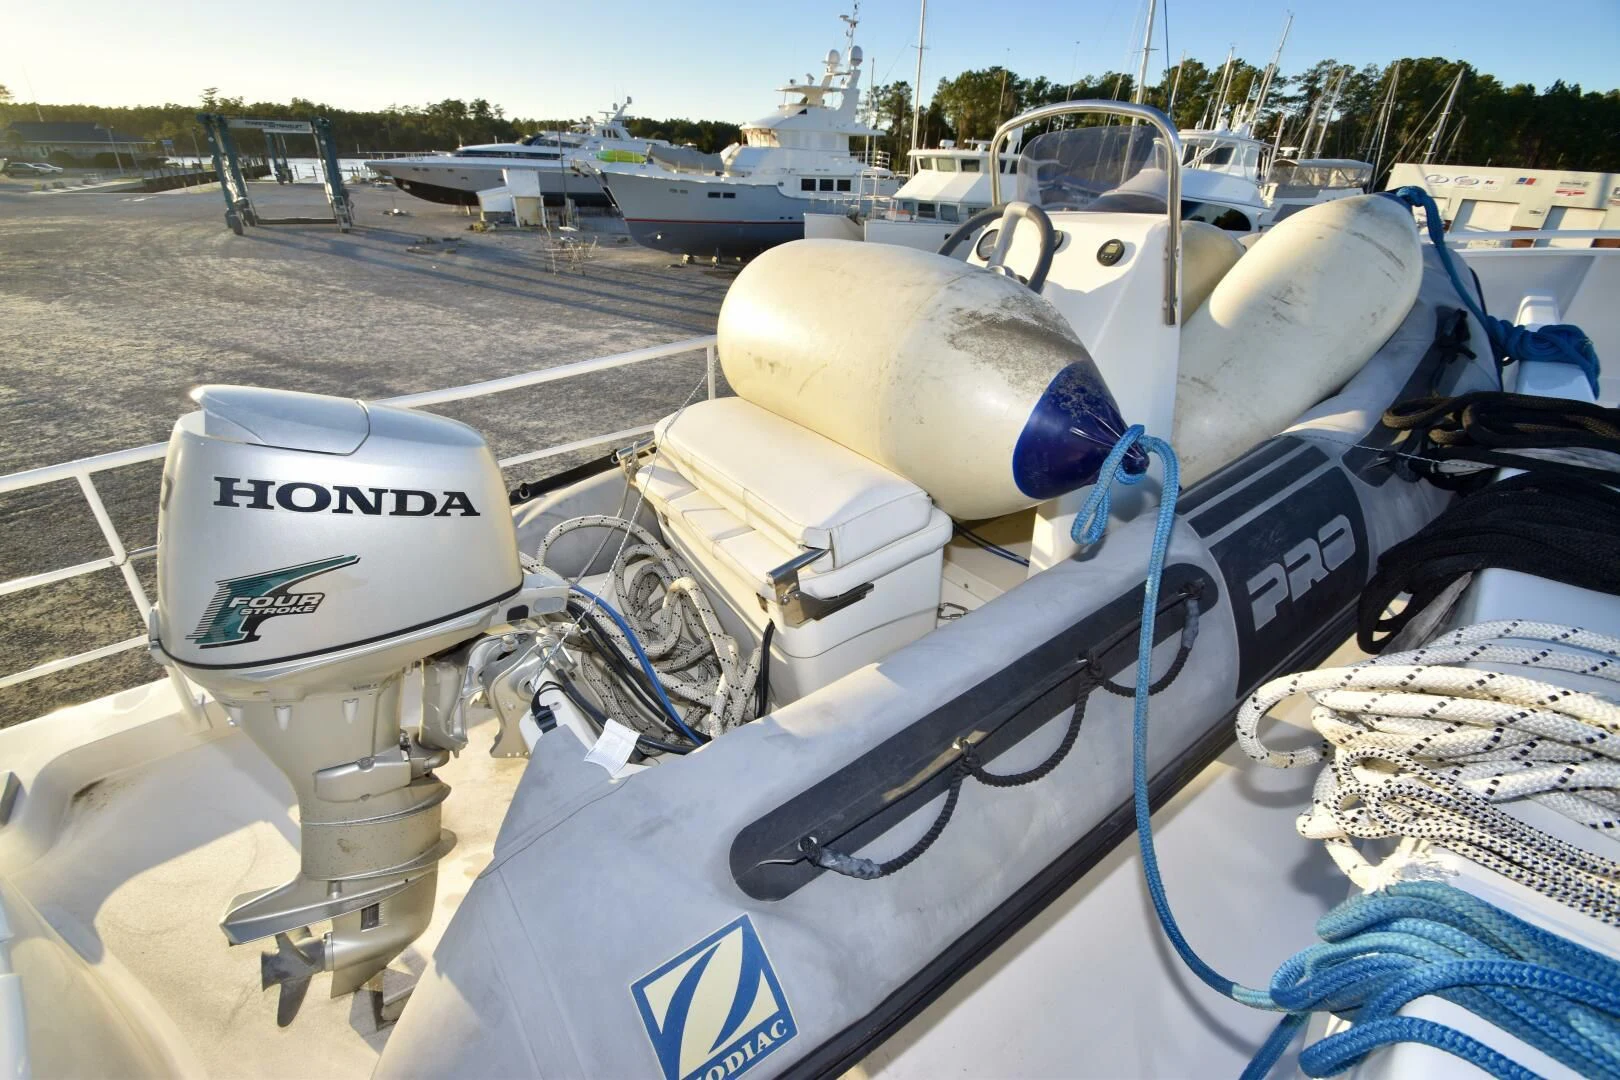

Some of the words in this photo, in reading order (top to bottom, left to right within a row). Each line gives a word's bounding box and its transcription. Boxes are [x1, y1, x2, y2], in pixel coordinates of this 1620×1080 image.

[213, 476, 480, 517] HONDA
[1246, 514, 1356, 632] PRO
[228, 594, 323, 608] FOUR
[240, 605, 315, 615] STROKE
[695, 1019, 787, 1080] ODIAC
